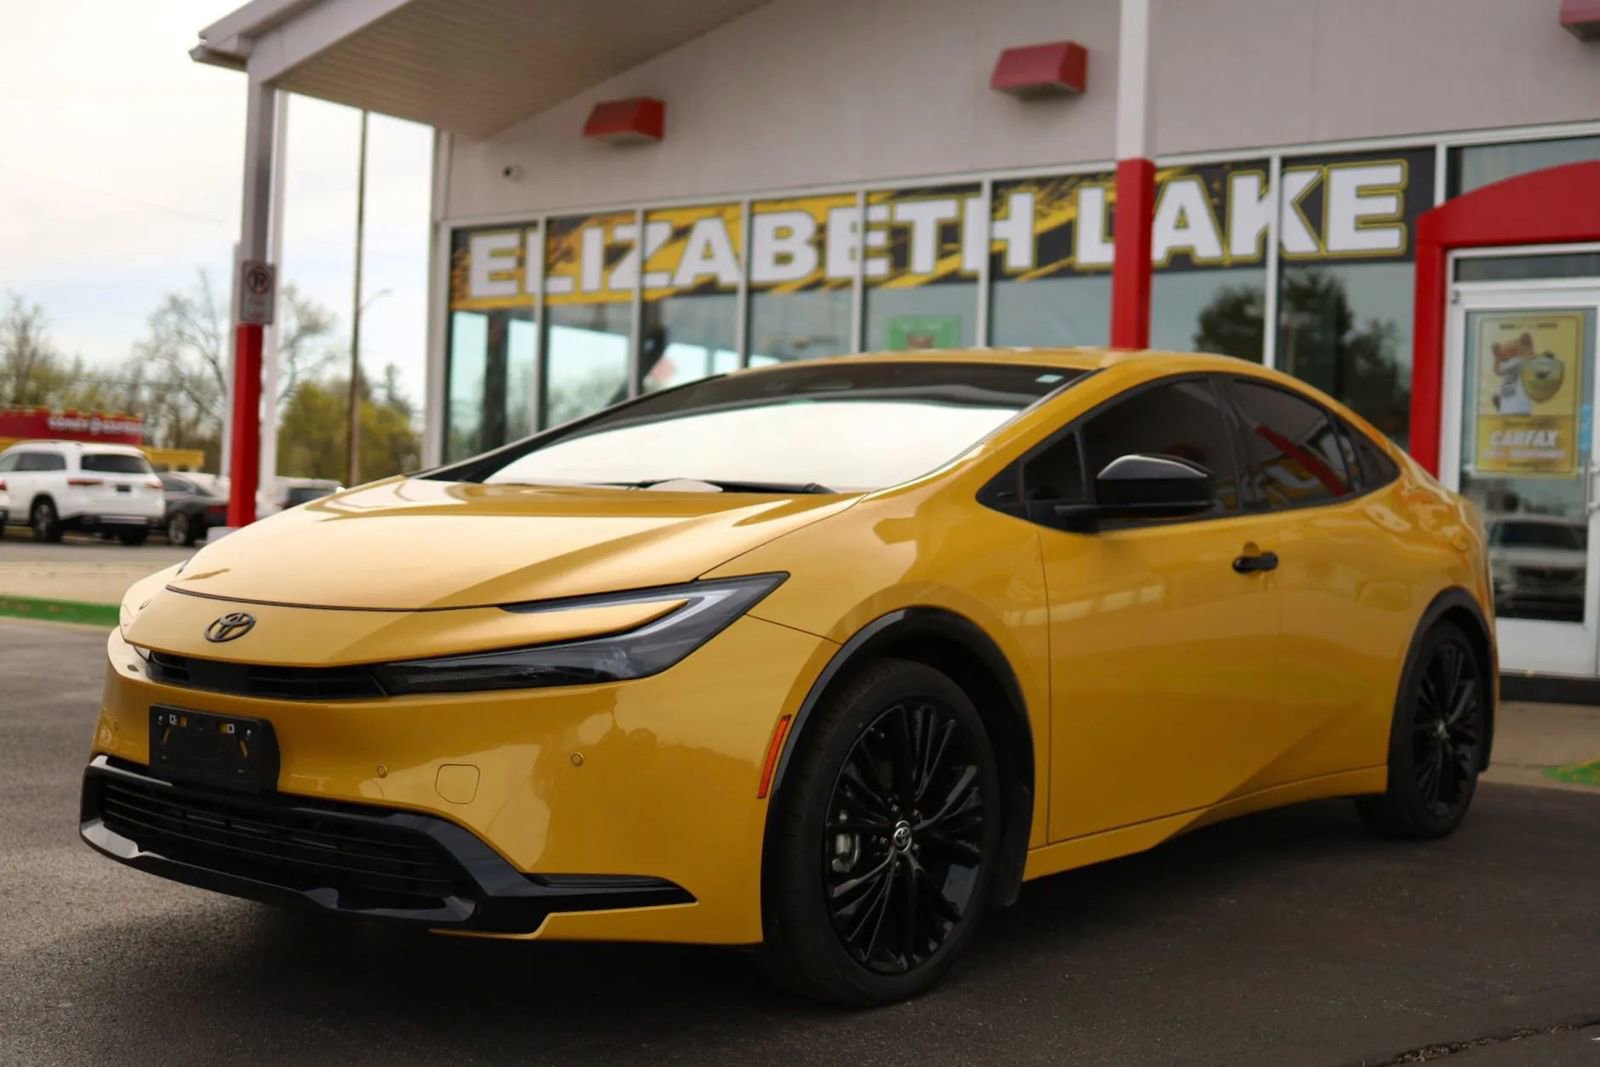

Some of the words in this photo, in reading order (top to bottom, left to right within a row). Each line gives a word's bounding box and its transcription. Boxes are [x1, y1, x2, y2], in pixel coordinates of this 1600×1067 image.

[469, 191, 1035, 297] ELIZABETH
[1076, 162, 1404, 265] LAKE
[1490, 430, 1558, 449] CARFAX
